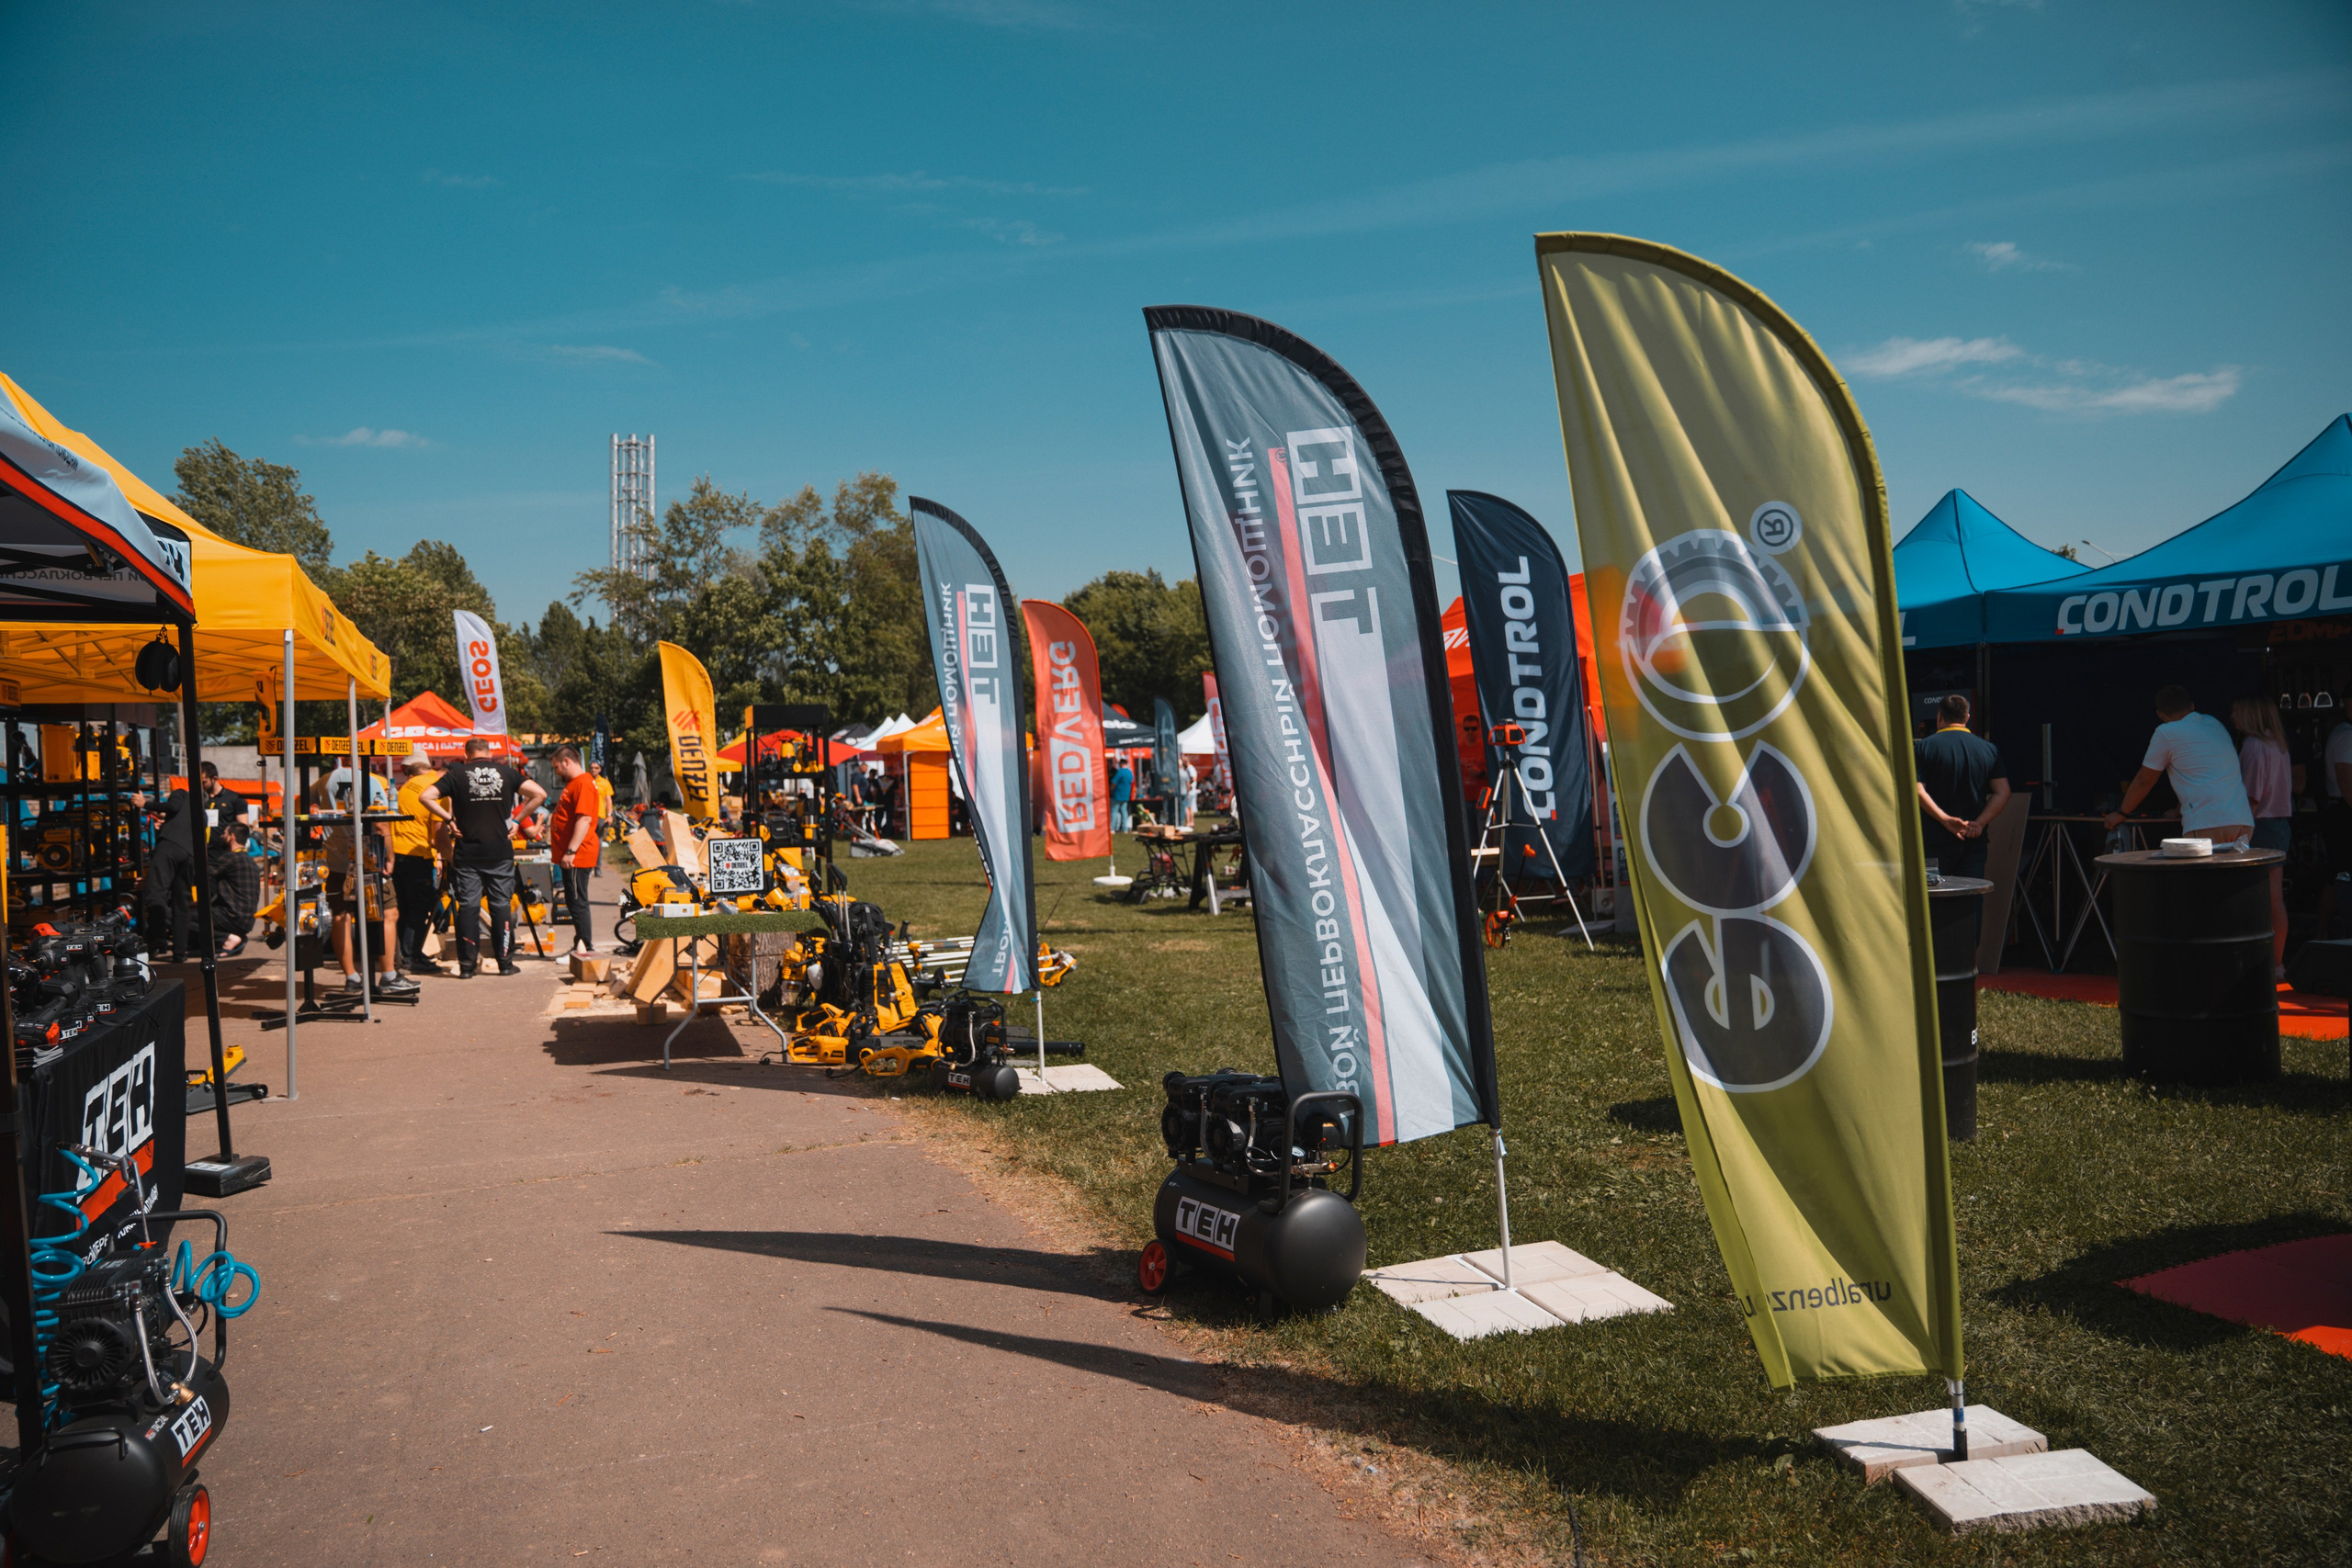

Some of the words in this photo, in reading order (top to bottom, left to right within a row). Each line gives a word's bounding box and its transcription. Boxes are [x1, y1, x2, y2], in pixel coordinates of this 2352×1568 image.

[2054, 565, 2352, 636] CONDTROL
[1498, 554, 1557, 820] CONDTROL
[381, 726, 473, 739] GEOS
[440, 742, 465, 751] ПАРК
